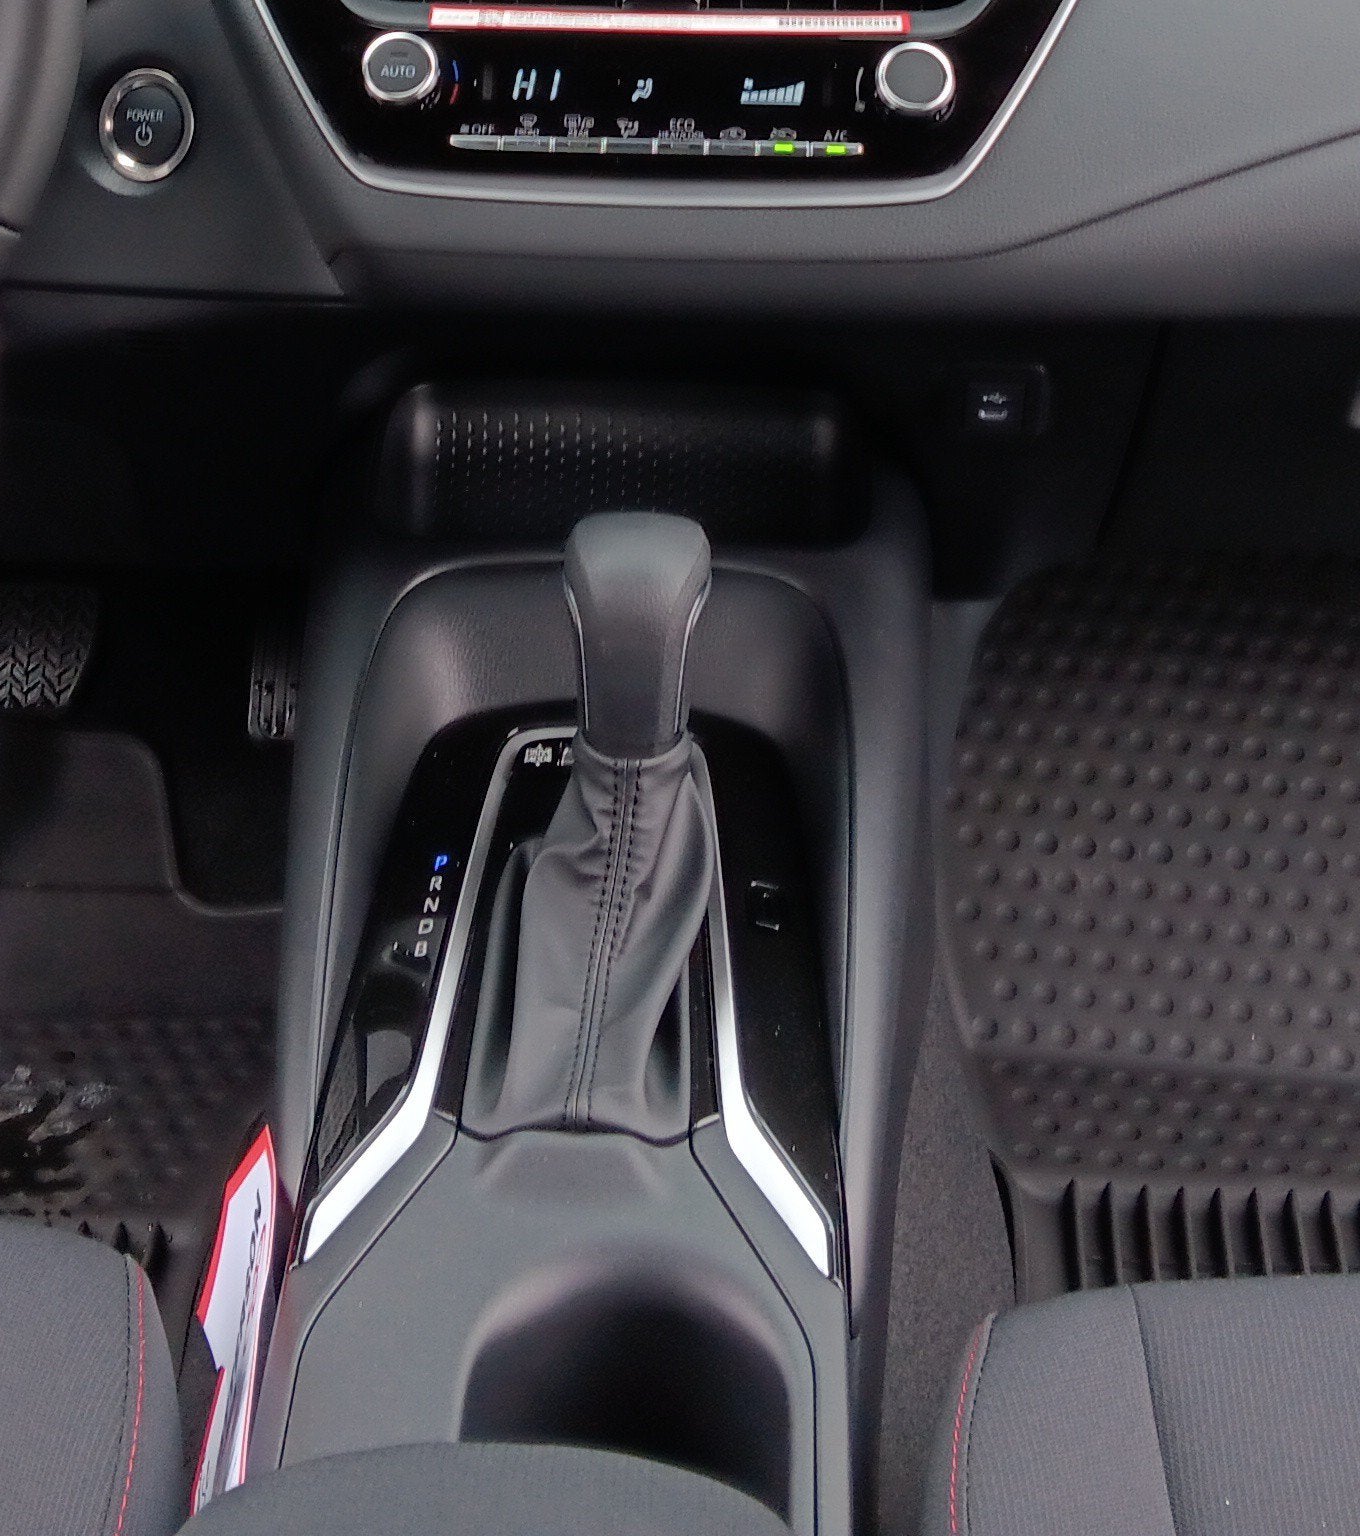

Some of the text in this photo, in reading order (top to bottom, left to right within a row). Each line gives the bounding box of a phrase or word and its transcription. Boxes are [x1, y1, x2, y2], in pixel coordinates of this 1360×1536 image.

[379, 63, 416, 79] AUTO
[126, 107, 165, 125] POWER
[471, 123, 496, 135] OFF
[669, 117, 696, 133] ECO
[823, 128, 848, 142] A/C
[433, 853, 449, 872] P
[429, 875, 444, 893] R
[423, 896, 439, 914] N
[417, 918, 434, 935] D
